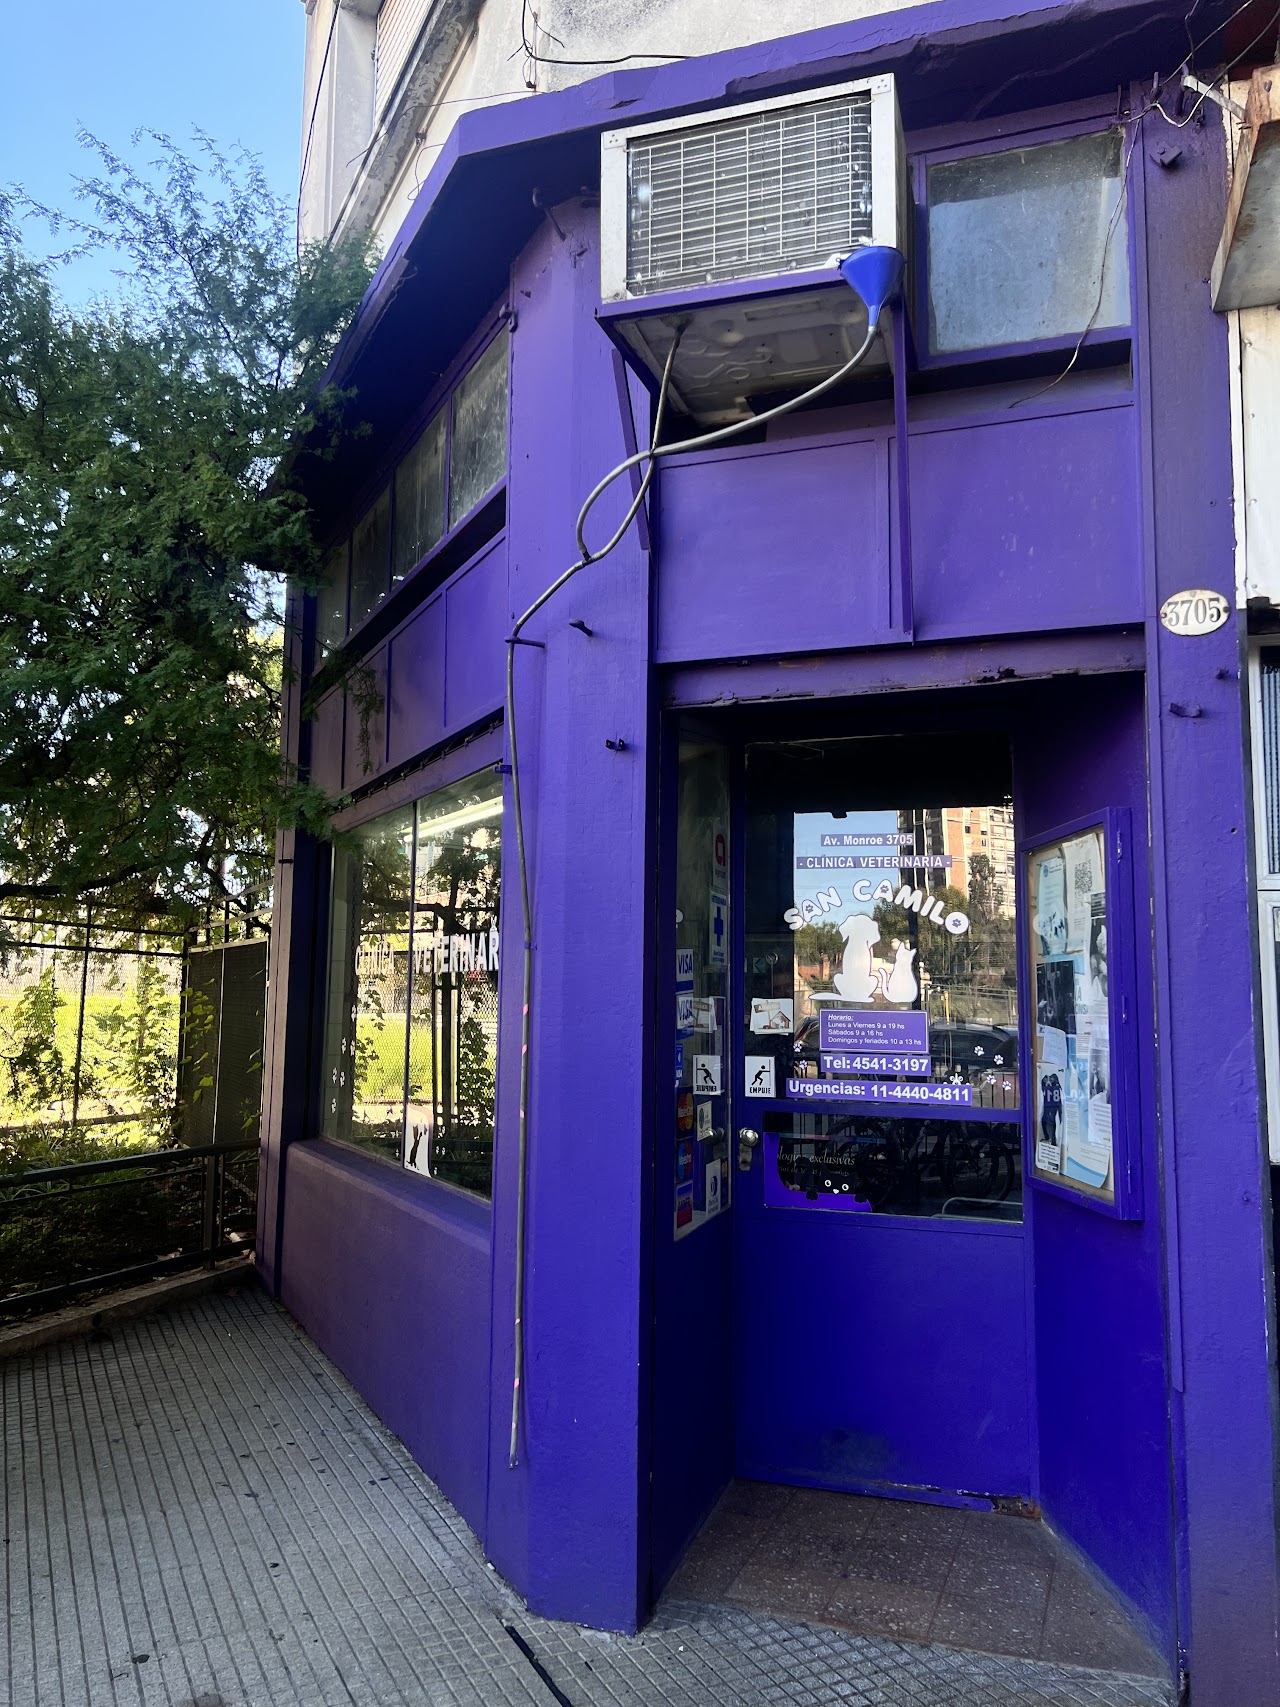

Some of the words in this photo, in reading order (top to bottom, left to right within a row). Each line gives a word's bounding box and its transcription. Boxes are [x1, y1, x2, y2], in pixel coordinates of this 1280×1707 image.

[1167, 597, 1221, 626] 3705
[823, 836, 840, 846] Av.
[843, 835, 883, 845] Monroe
[886, 834, 913, 845] 3705
[859, 856, 943, 868] VETERINARIA
[783, 886, 843, 931] SAN
[852, 879, 970, 935] CAMILO
[678, 953, 693, 975] VISA
[828, 1013, 854, 1021] Horario:
[828, 1021, 846, 1029] Lunes
[828, 1036, 858, 1045] Domingos
[864, 1037, 888, 1045] feriados
[823, 1056, 850, 1070] Tel:
[853, 1058, 929, 1072] 4541-3197
[789, 1080, 865, 1096] Urgencias:
[871, 1085, 969, 1101] 11-4440-4811
[809, 1148, 856, 1166] exclusivas
